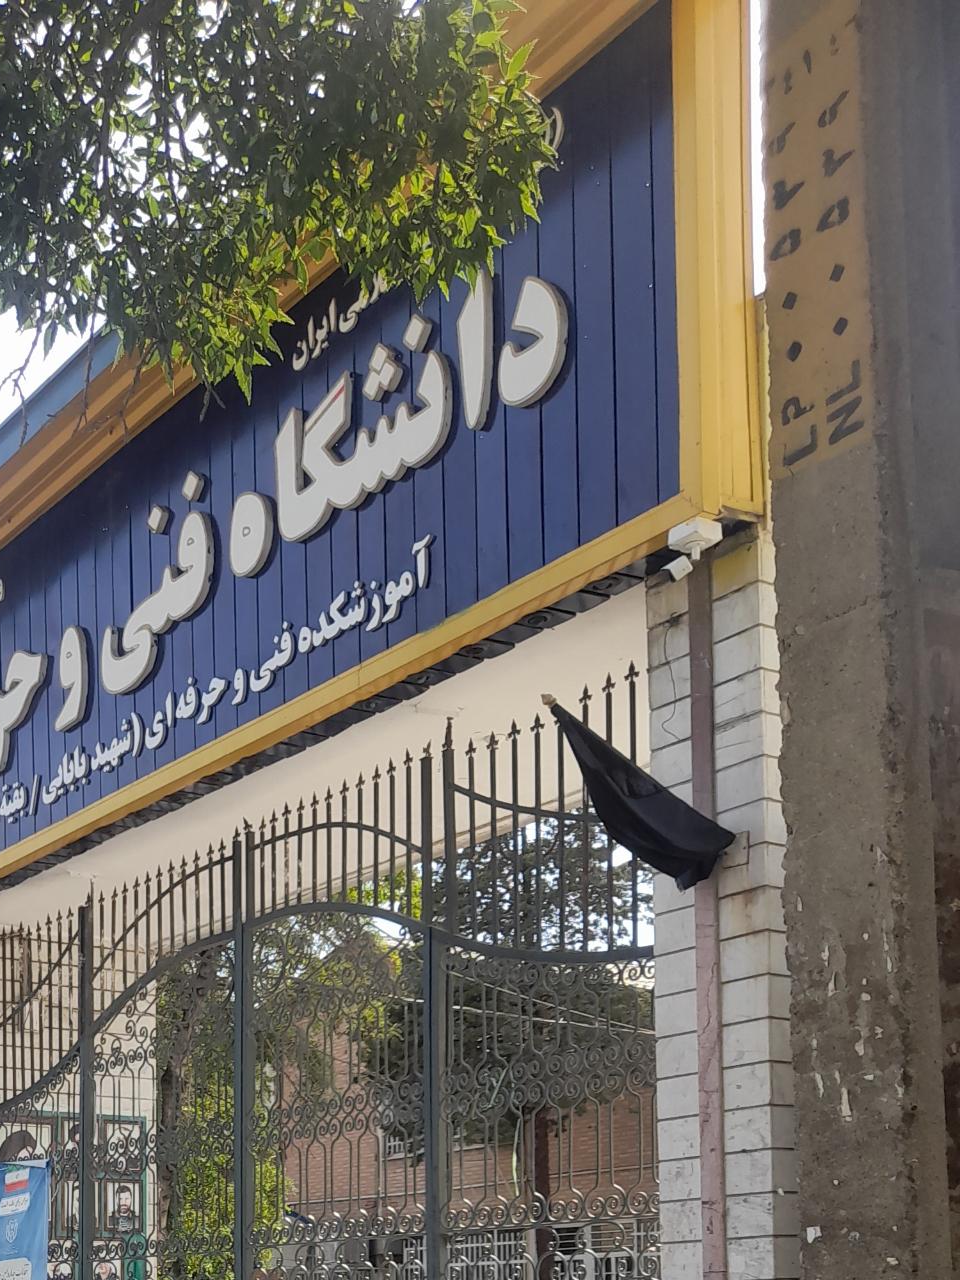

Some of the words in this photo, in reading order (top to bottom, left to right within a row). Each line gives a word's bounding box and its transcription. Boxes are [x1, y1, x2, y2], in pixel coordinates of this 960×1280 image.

[292, 297, 337, 372] ایران
[229, 264, 569, 579] دانشگاه
[781, 396, 817, 467] LP
[825, 359, 865, 445] NL
[100, 470, 215, 695] فنی
[297, 533, 434, 654] آموزشکده
[53, 624, 89, 732] و
[231, 667, 248, 706] و
[248, 621, 295, 692] فنی
[41, 745, 88, 805] بابایی
